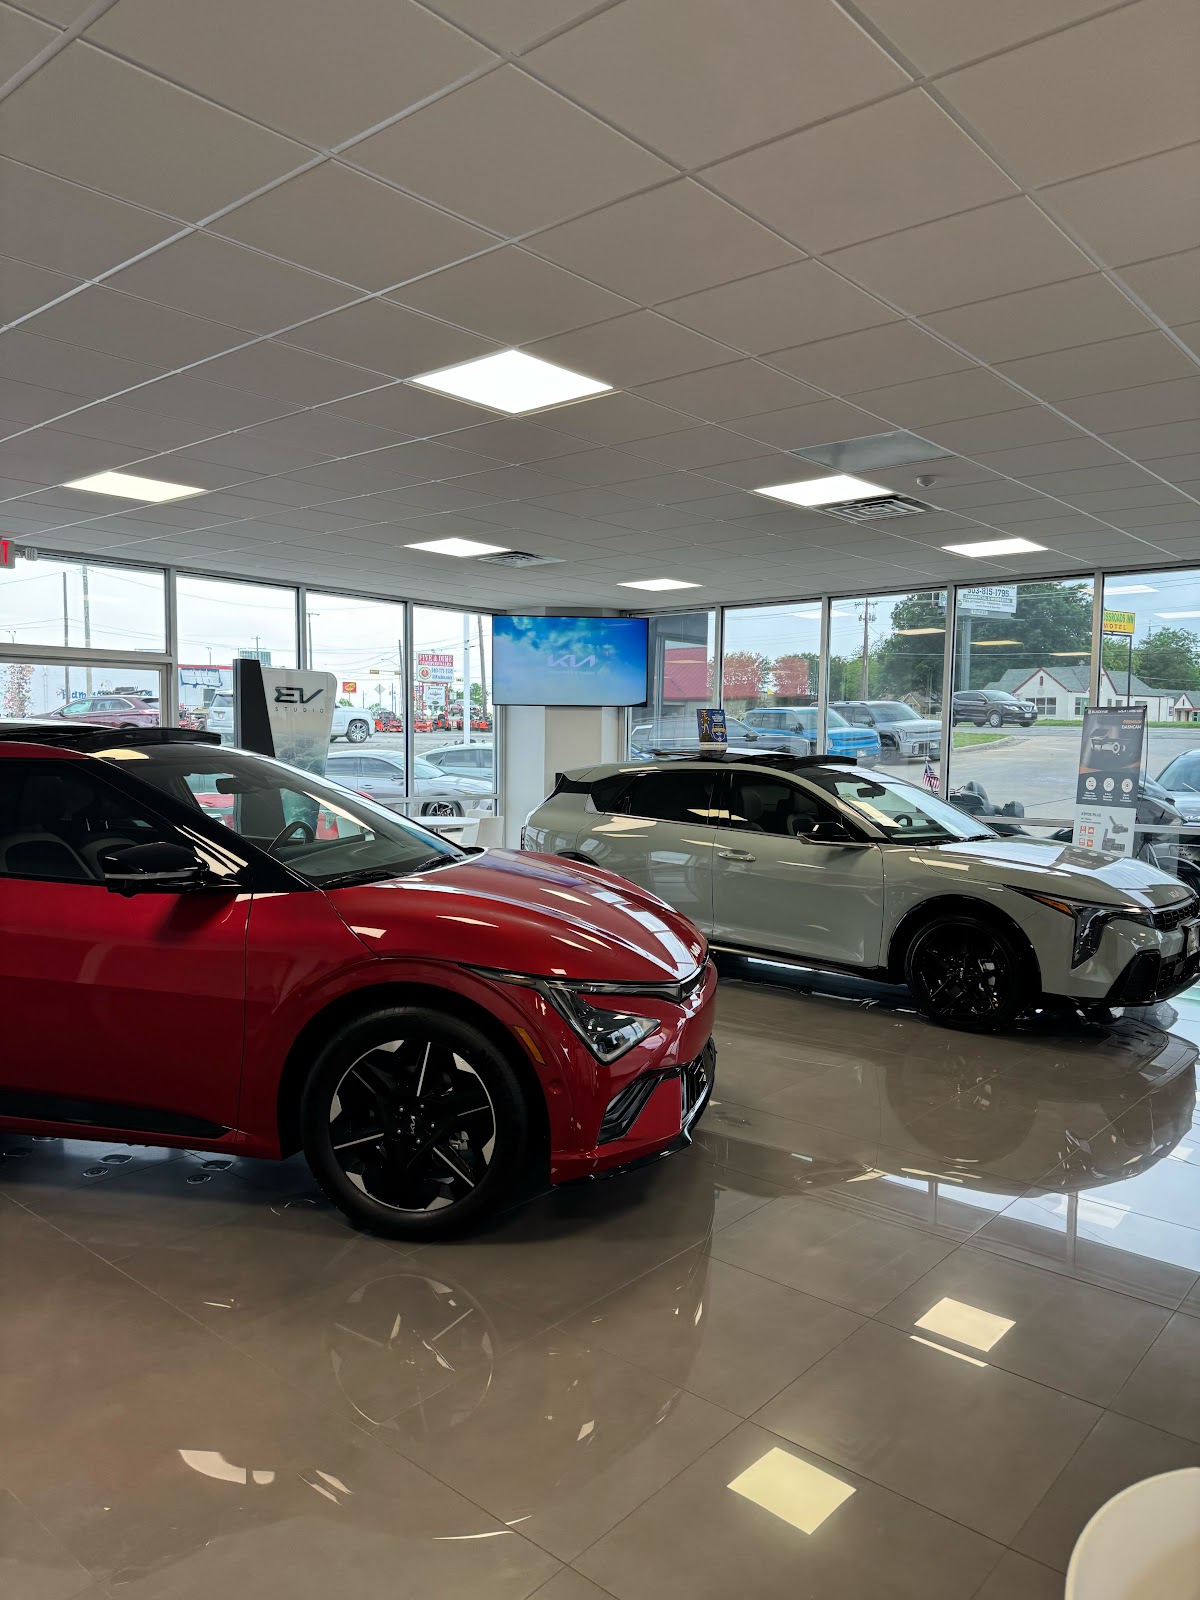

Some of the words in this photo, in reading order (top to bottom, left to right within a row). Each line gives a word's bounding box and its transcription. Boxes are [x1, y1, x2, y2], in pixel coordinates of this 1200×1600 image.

[0, 541, 10, 565] T
[419, 654, 433, 662] FIVE
[438, 655, 453, 663] DIME
[547, 655, 595, 667] KIA
[274, 686, 324, 703] EV
